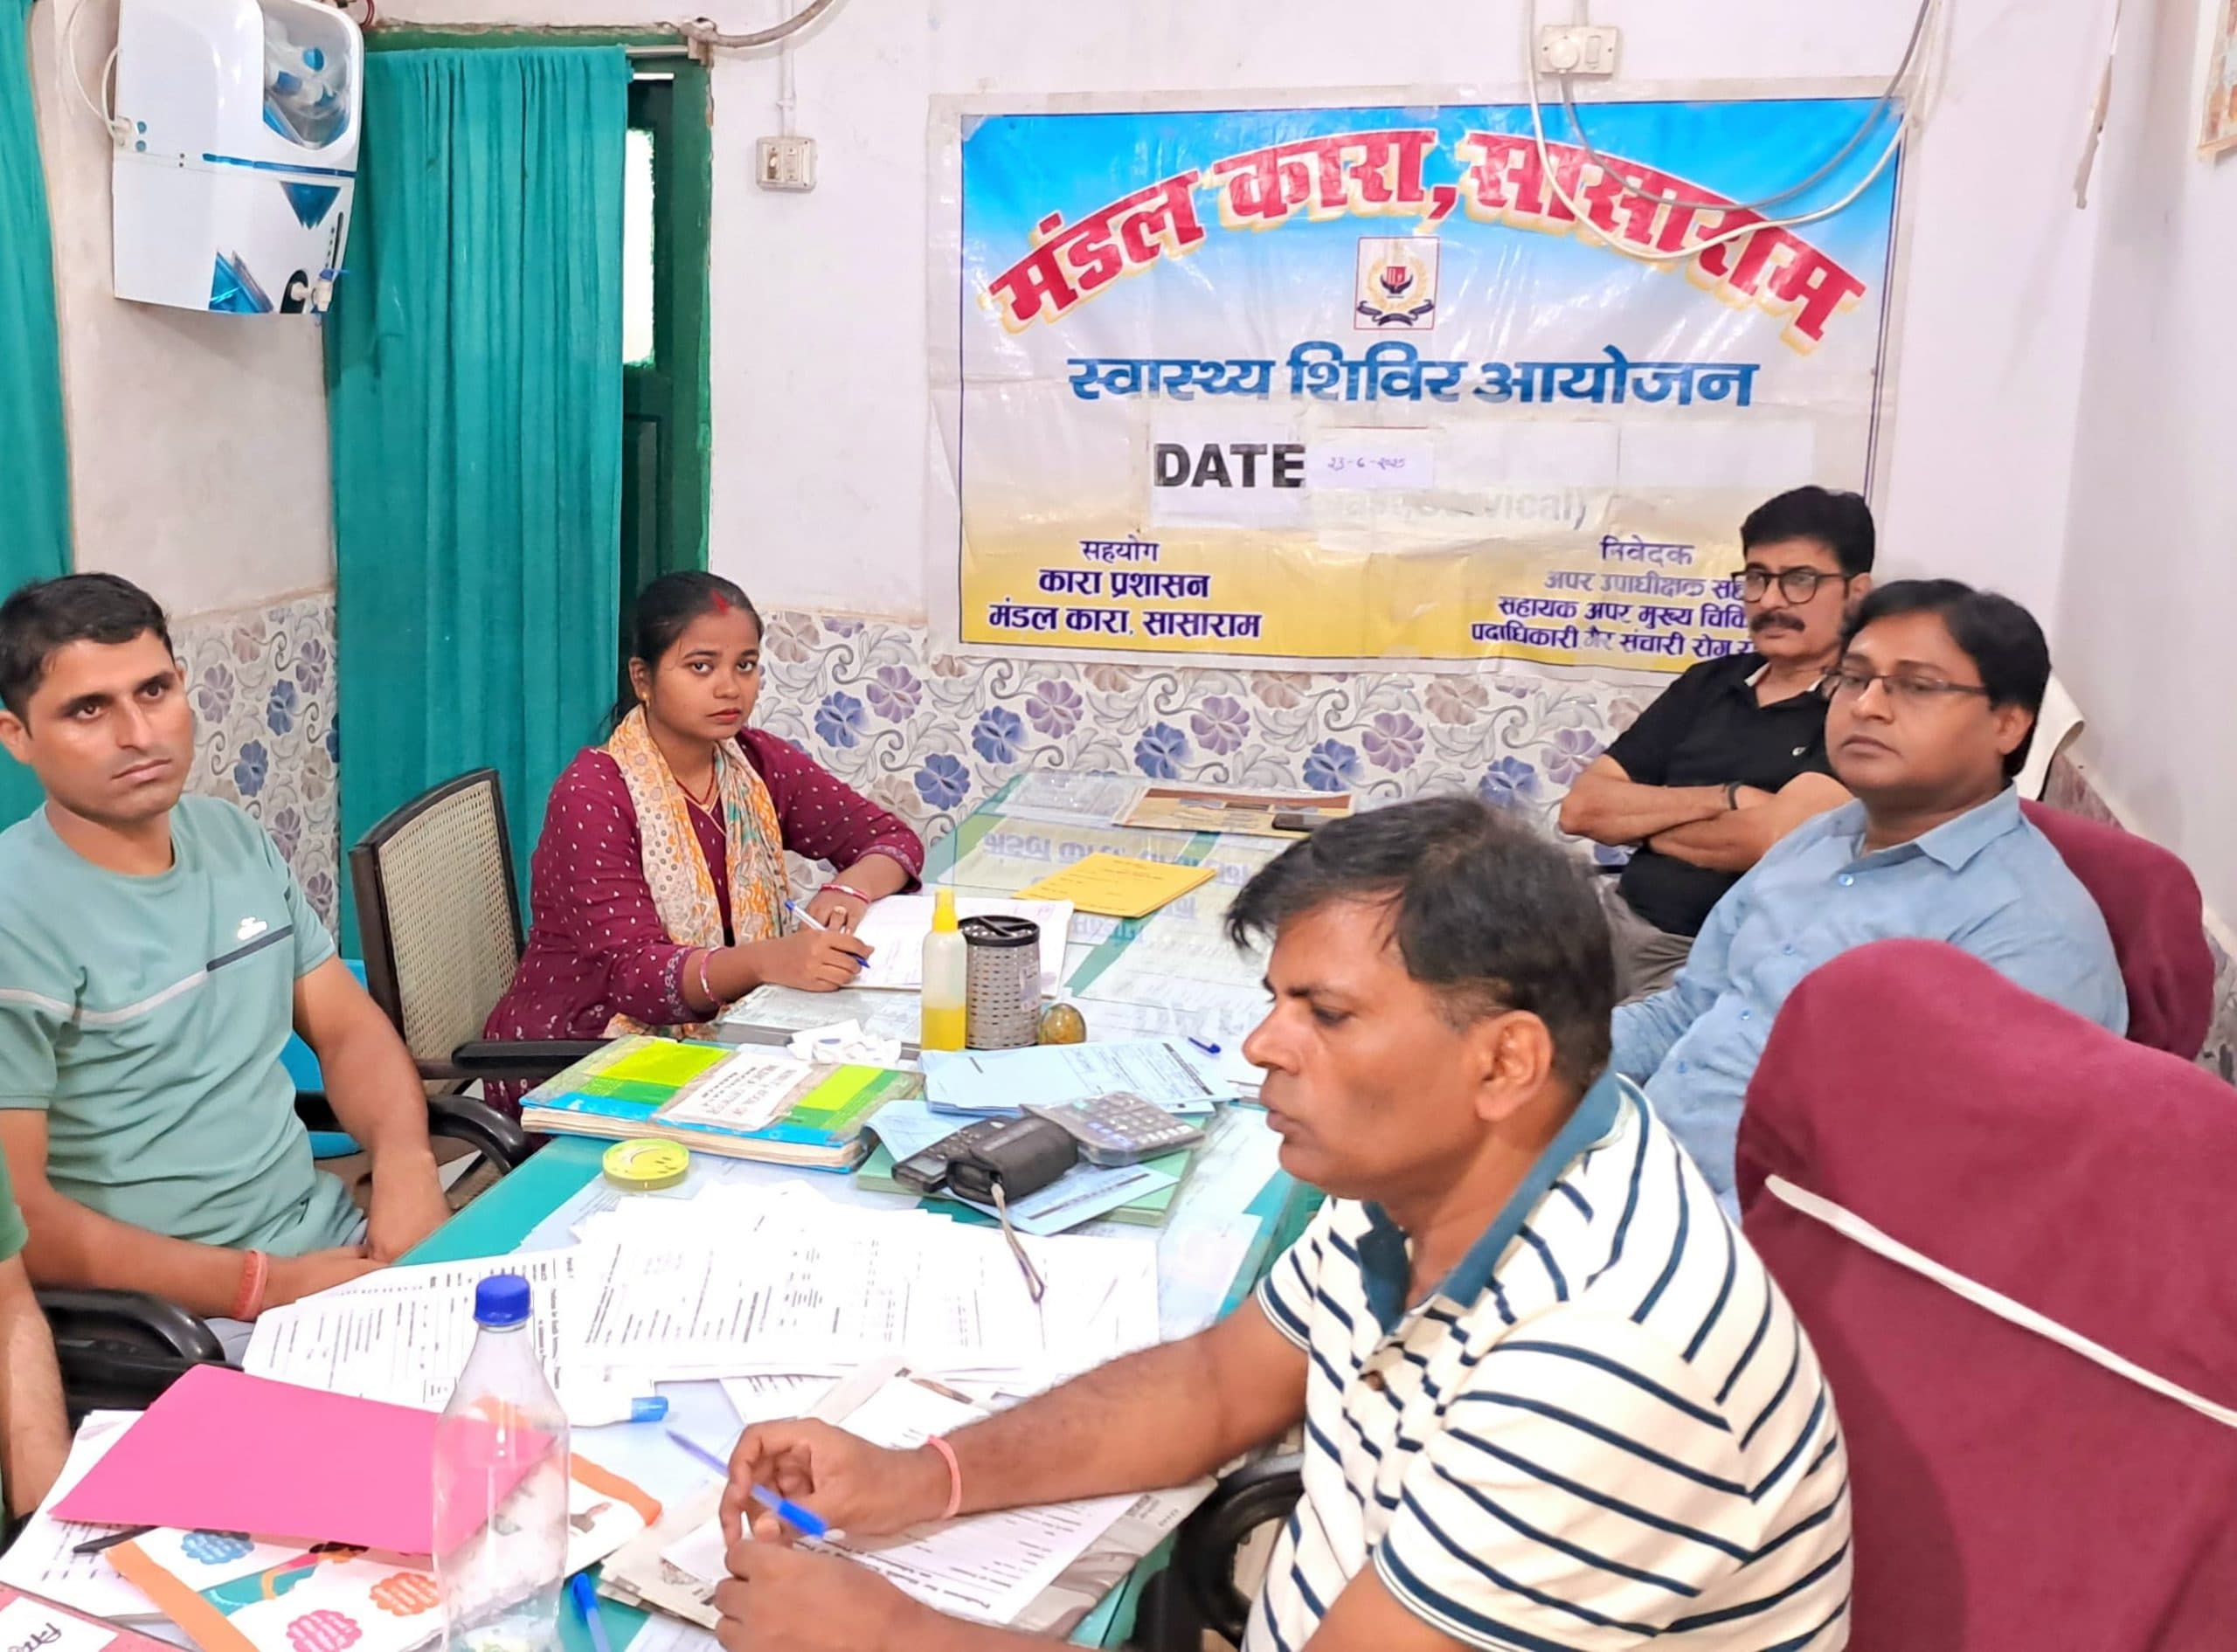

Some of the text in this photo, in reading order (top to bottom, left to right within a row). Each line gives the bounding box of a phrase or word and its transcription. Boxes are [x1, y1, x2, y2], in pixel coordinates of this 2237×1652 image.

[987, 129, 1867, 342] मंडल कारा, सासाराम
[1066, 340, 1761, 407] स्वास्थ्य शिविर आयोजन
[1153, 443, 1306, 488] DATE
[1079, 535, 1160, 562] सहयोग
[1599, 535, 1695, 568] निवेदक
[1038, 569, 1210, 599] कारा प्रशासन
[1545, 570, 1596, 591] अपर
[988, 597, 1058, 630] मंडल
[1142, 611, 1263, 639] सासाराम
[1498, 596, 1578, 619] सहायक
[1584, 602, 1633, 625] अपर
[1637, 605, 1693, 630] मुख्य
[1619, 628, 1684, 656] संचारी
[1691, 633, 1733, 657] रोग
